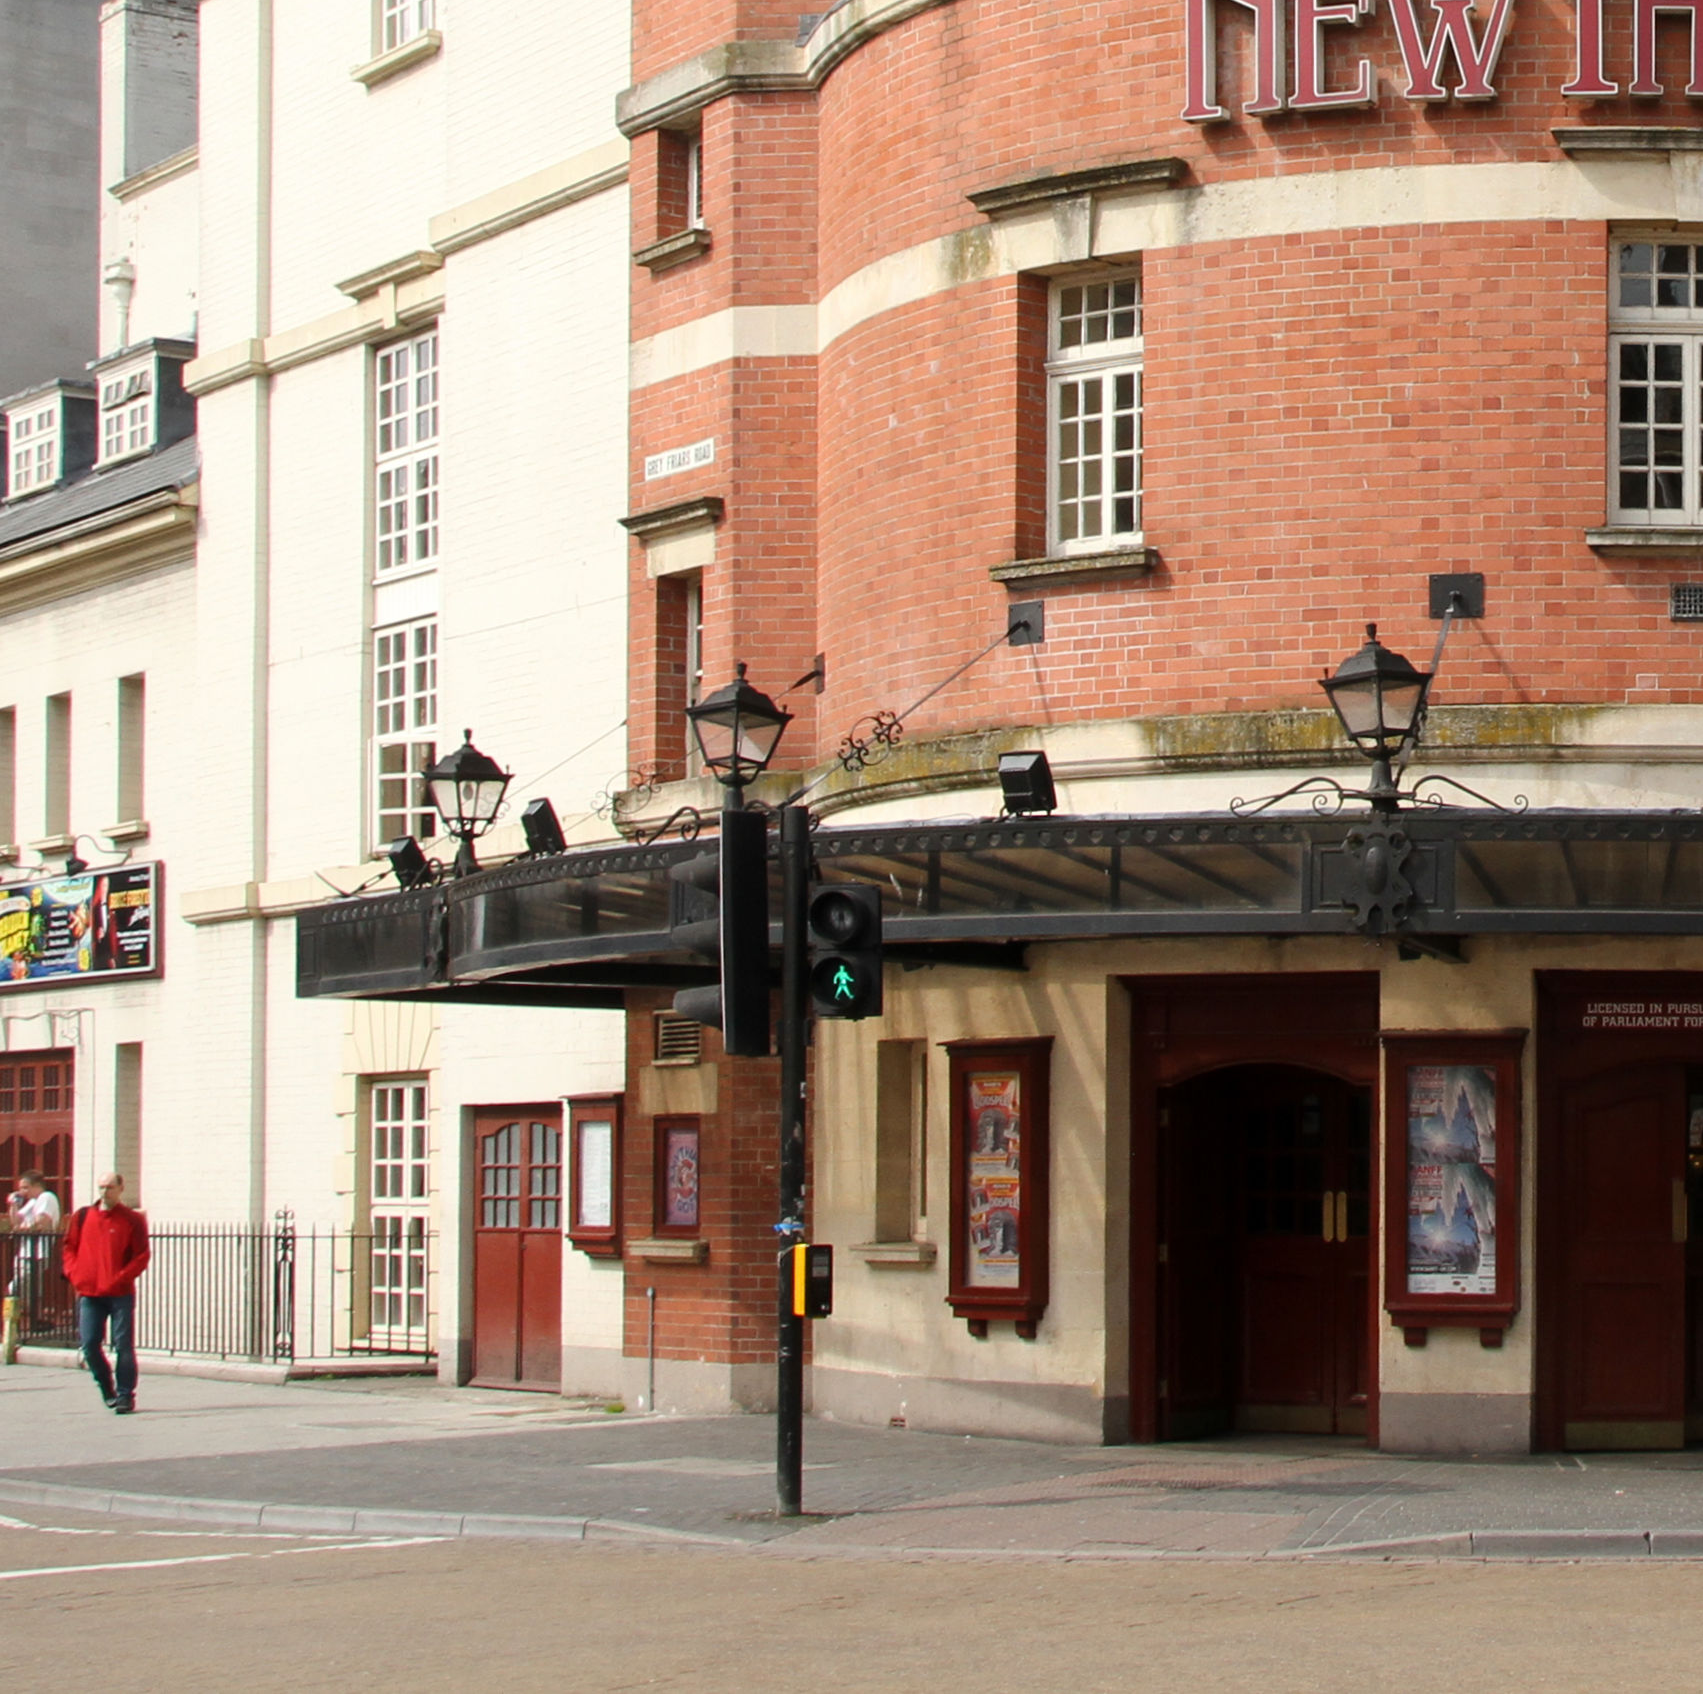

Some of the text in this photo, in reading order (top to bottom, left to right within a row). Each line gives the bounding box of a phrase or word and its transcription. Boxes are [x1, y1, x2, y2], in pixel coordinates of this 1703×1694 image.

[647, 444, 710, 476] GREY FRIARS ROAD
[1586, 1003, 1645, 1015] LICENSED
[1649, 1003, 1662, 1015] IN
[1582, 1016, 1597, 1027] OF
[1602, 1016, 1680, 1027] PARLIAMENT
